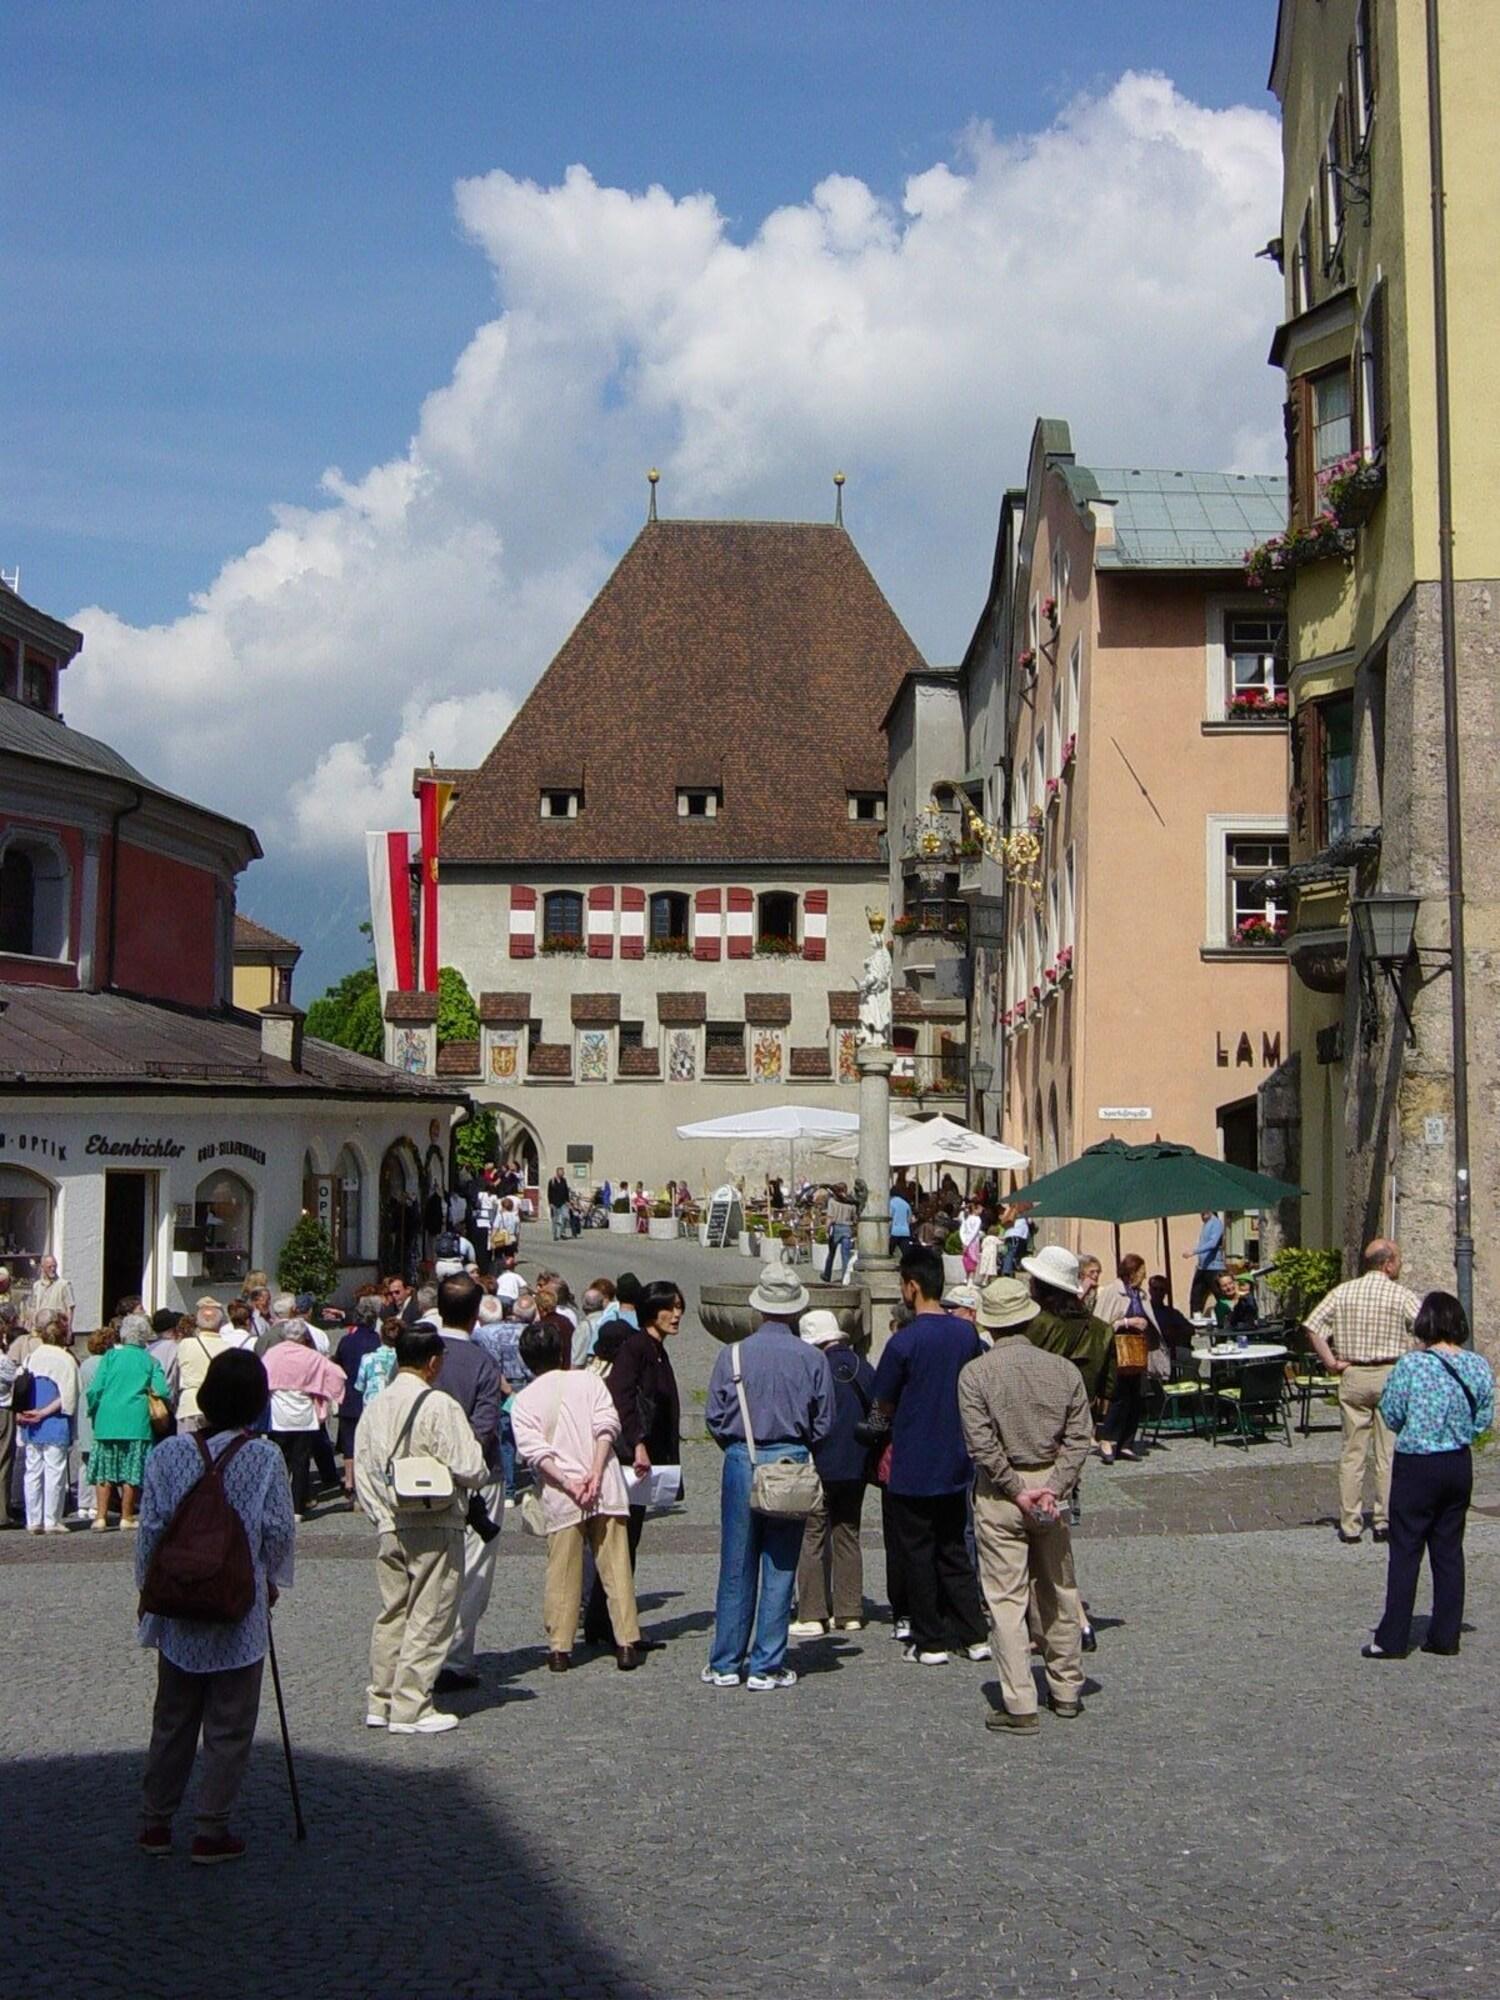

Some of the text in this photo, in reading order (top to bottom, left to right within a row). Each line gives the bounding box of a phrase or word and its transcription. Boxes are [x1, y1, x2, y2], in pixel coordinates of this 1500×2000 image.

[1216, 1031, 1281, 1068] LAM
[19, 1134, 67, 1161] OPTIK
[85, 1134, 186, 1159] Ebenbichler
